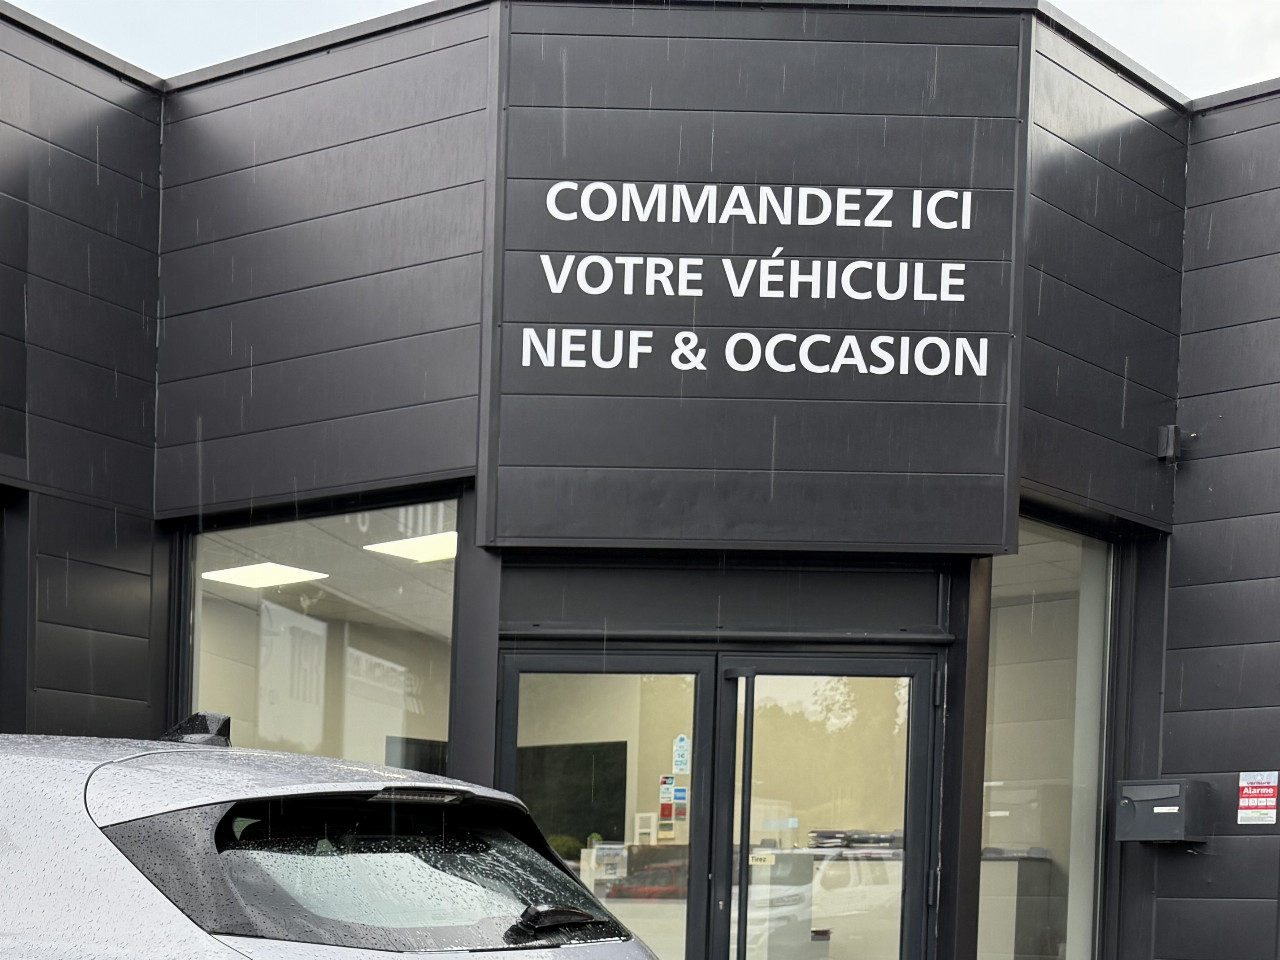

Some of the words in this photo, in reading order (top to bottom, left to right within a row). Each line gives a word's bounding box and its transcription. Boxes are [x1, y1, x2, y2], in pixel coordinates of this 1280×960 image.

[546, 180, 894, 228] COMMANDEZ
[912, 189, 972, 230] ICI
[539, 254, 704, 297] VOTRE
[721, 246, 966, 302] VÉHICULE
[521, 327, 654, 369] NEUF
[670, 330, 707, 371] &
[724, 332, 988, 377] OCCASION
